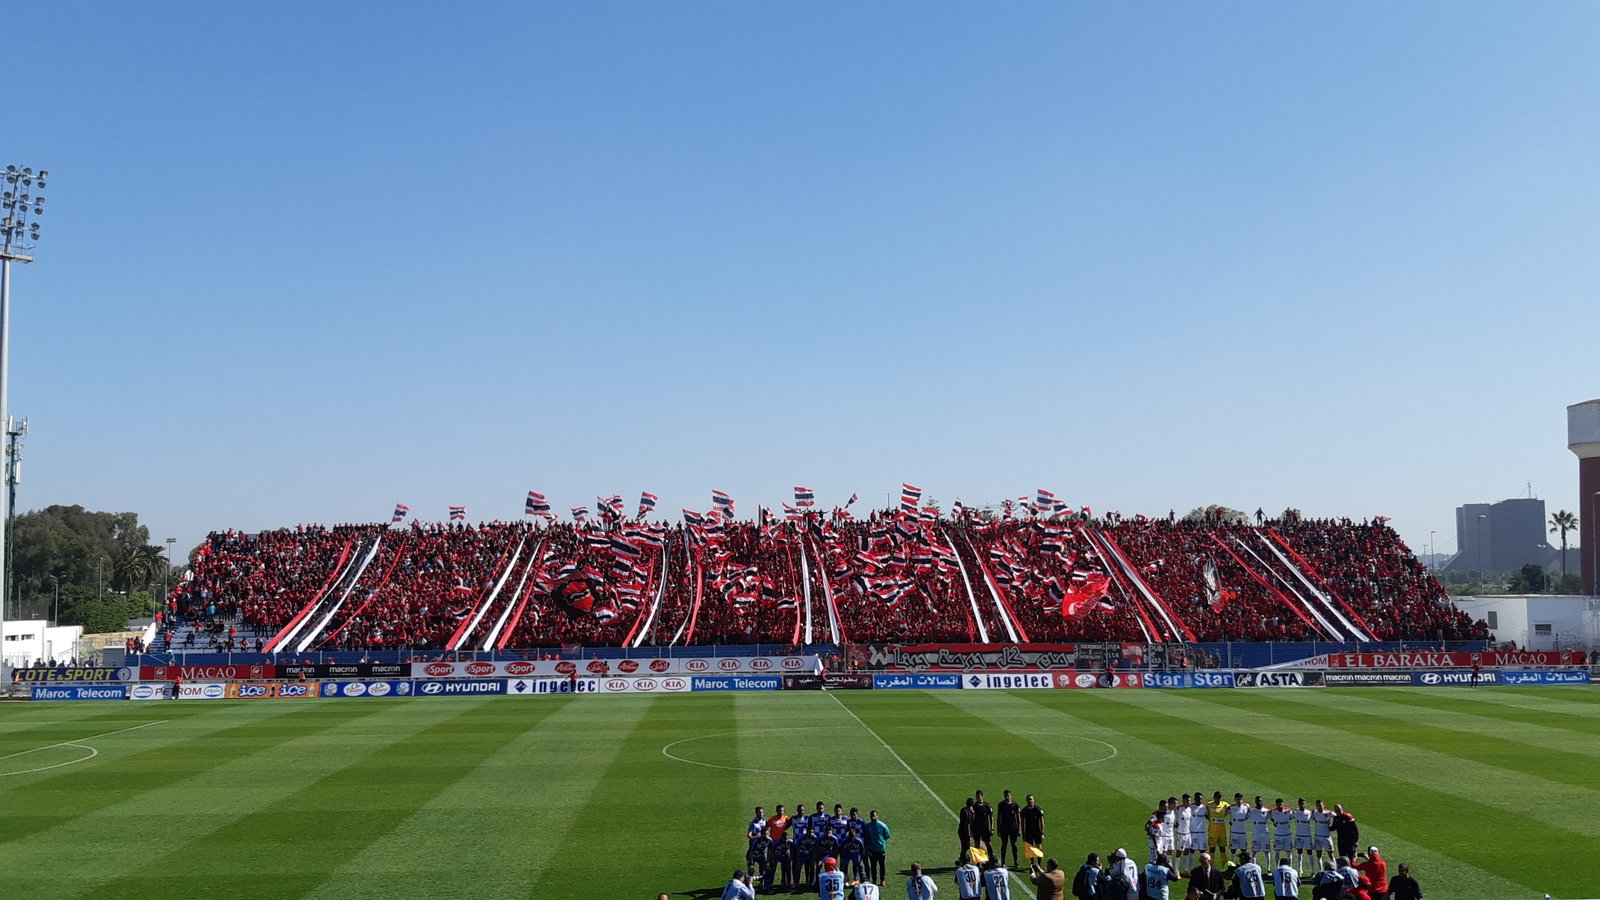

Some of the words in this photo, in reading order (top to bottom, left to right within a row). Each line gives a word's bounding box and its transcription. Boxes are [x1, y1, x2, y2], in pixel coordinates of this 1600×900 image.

[1344, 655, 1367, 667] EL
[1373, 654, 1454, 667] BARAKA
[1495, 653, 1547, 665] MACAO
[65, 669, 115, 681] SPORT
[181, 667, 236, 680] MACAO
[1194, 673, 1231, 685] Star
[1506, 672, 1542, 683] المغرب
[1545, 670, 1586, 681] اتصالات
[637, 681, 654, 689] KIA
[695, 679, 729, 688] Maroc
[733, 678, 777, 688] Telecom
[876, 677, 913, 687] المغرب
[917, 677, 958, 685] اتصالات
[986, 674, 1049, 688] ingelec
[1144, 673, 1181, 686] Star
[1260, 673, 1300, 686] ASTA
[445, 683, 500, 692] HYUNDAI
[532, 680, 596, 692] ingeec
[35, 689, 71, 698] Maroc
[77, 688, 122, 698] Telecom
[155, 688, 201, 696] PEROM
[964, 871, 976, 882] 30
[826, 879, 840, 891] 35
[863, 885, 873, 895] 17
